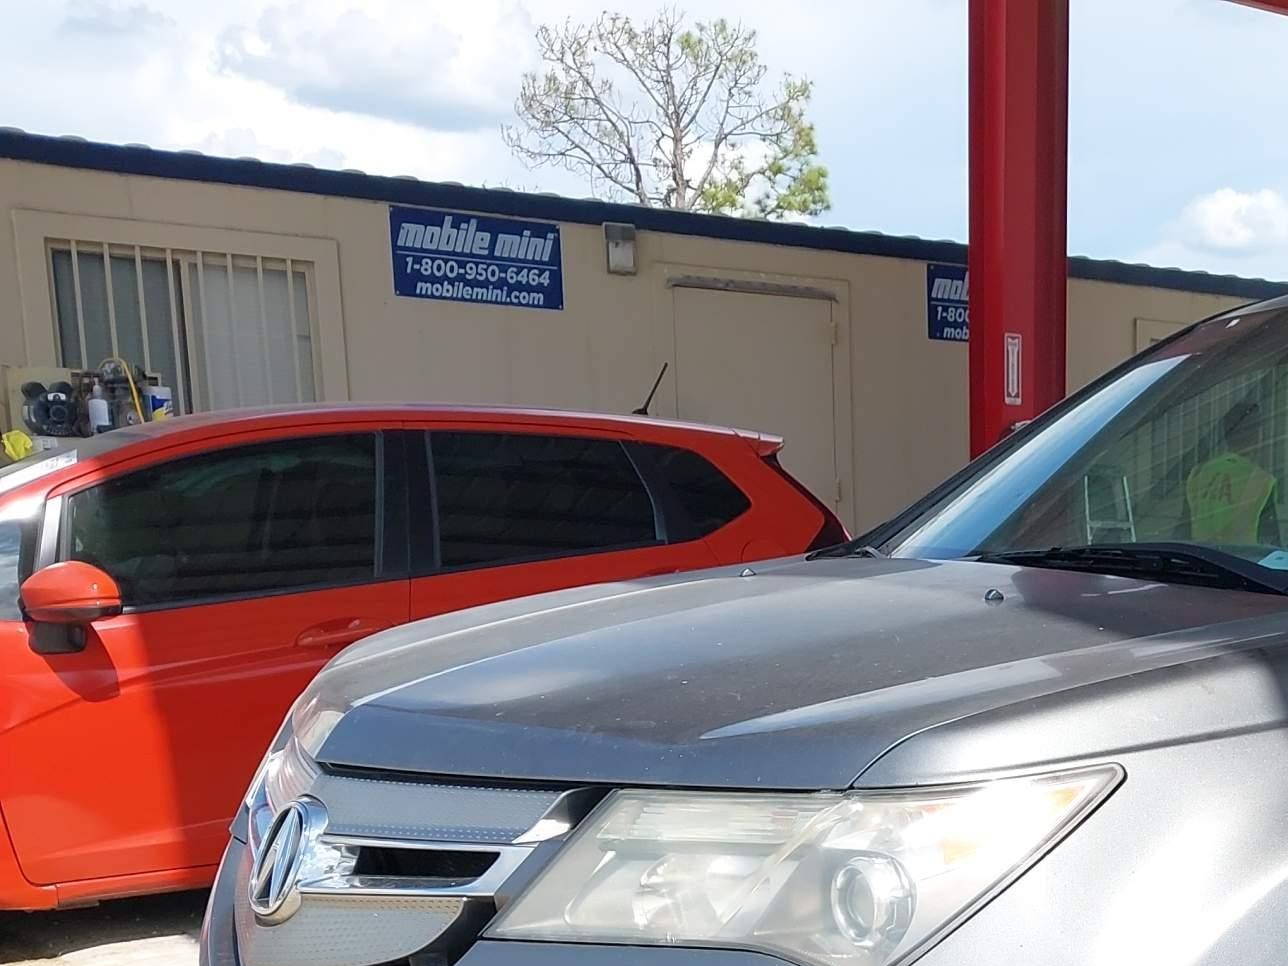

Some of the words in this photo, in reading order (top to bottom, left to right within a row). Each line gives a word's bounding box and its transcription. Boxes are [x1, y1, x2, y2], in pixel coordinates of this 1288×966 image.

[396, 215, 491, 255] mobile
[494, 230, 555, 262] mini
[405, 256, 550, 286] 1-800-950-6464
[416, 281, 544, 305] mobilemini.com
